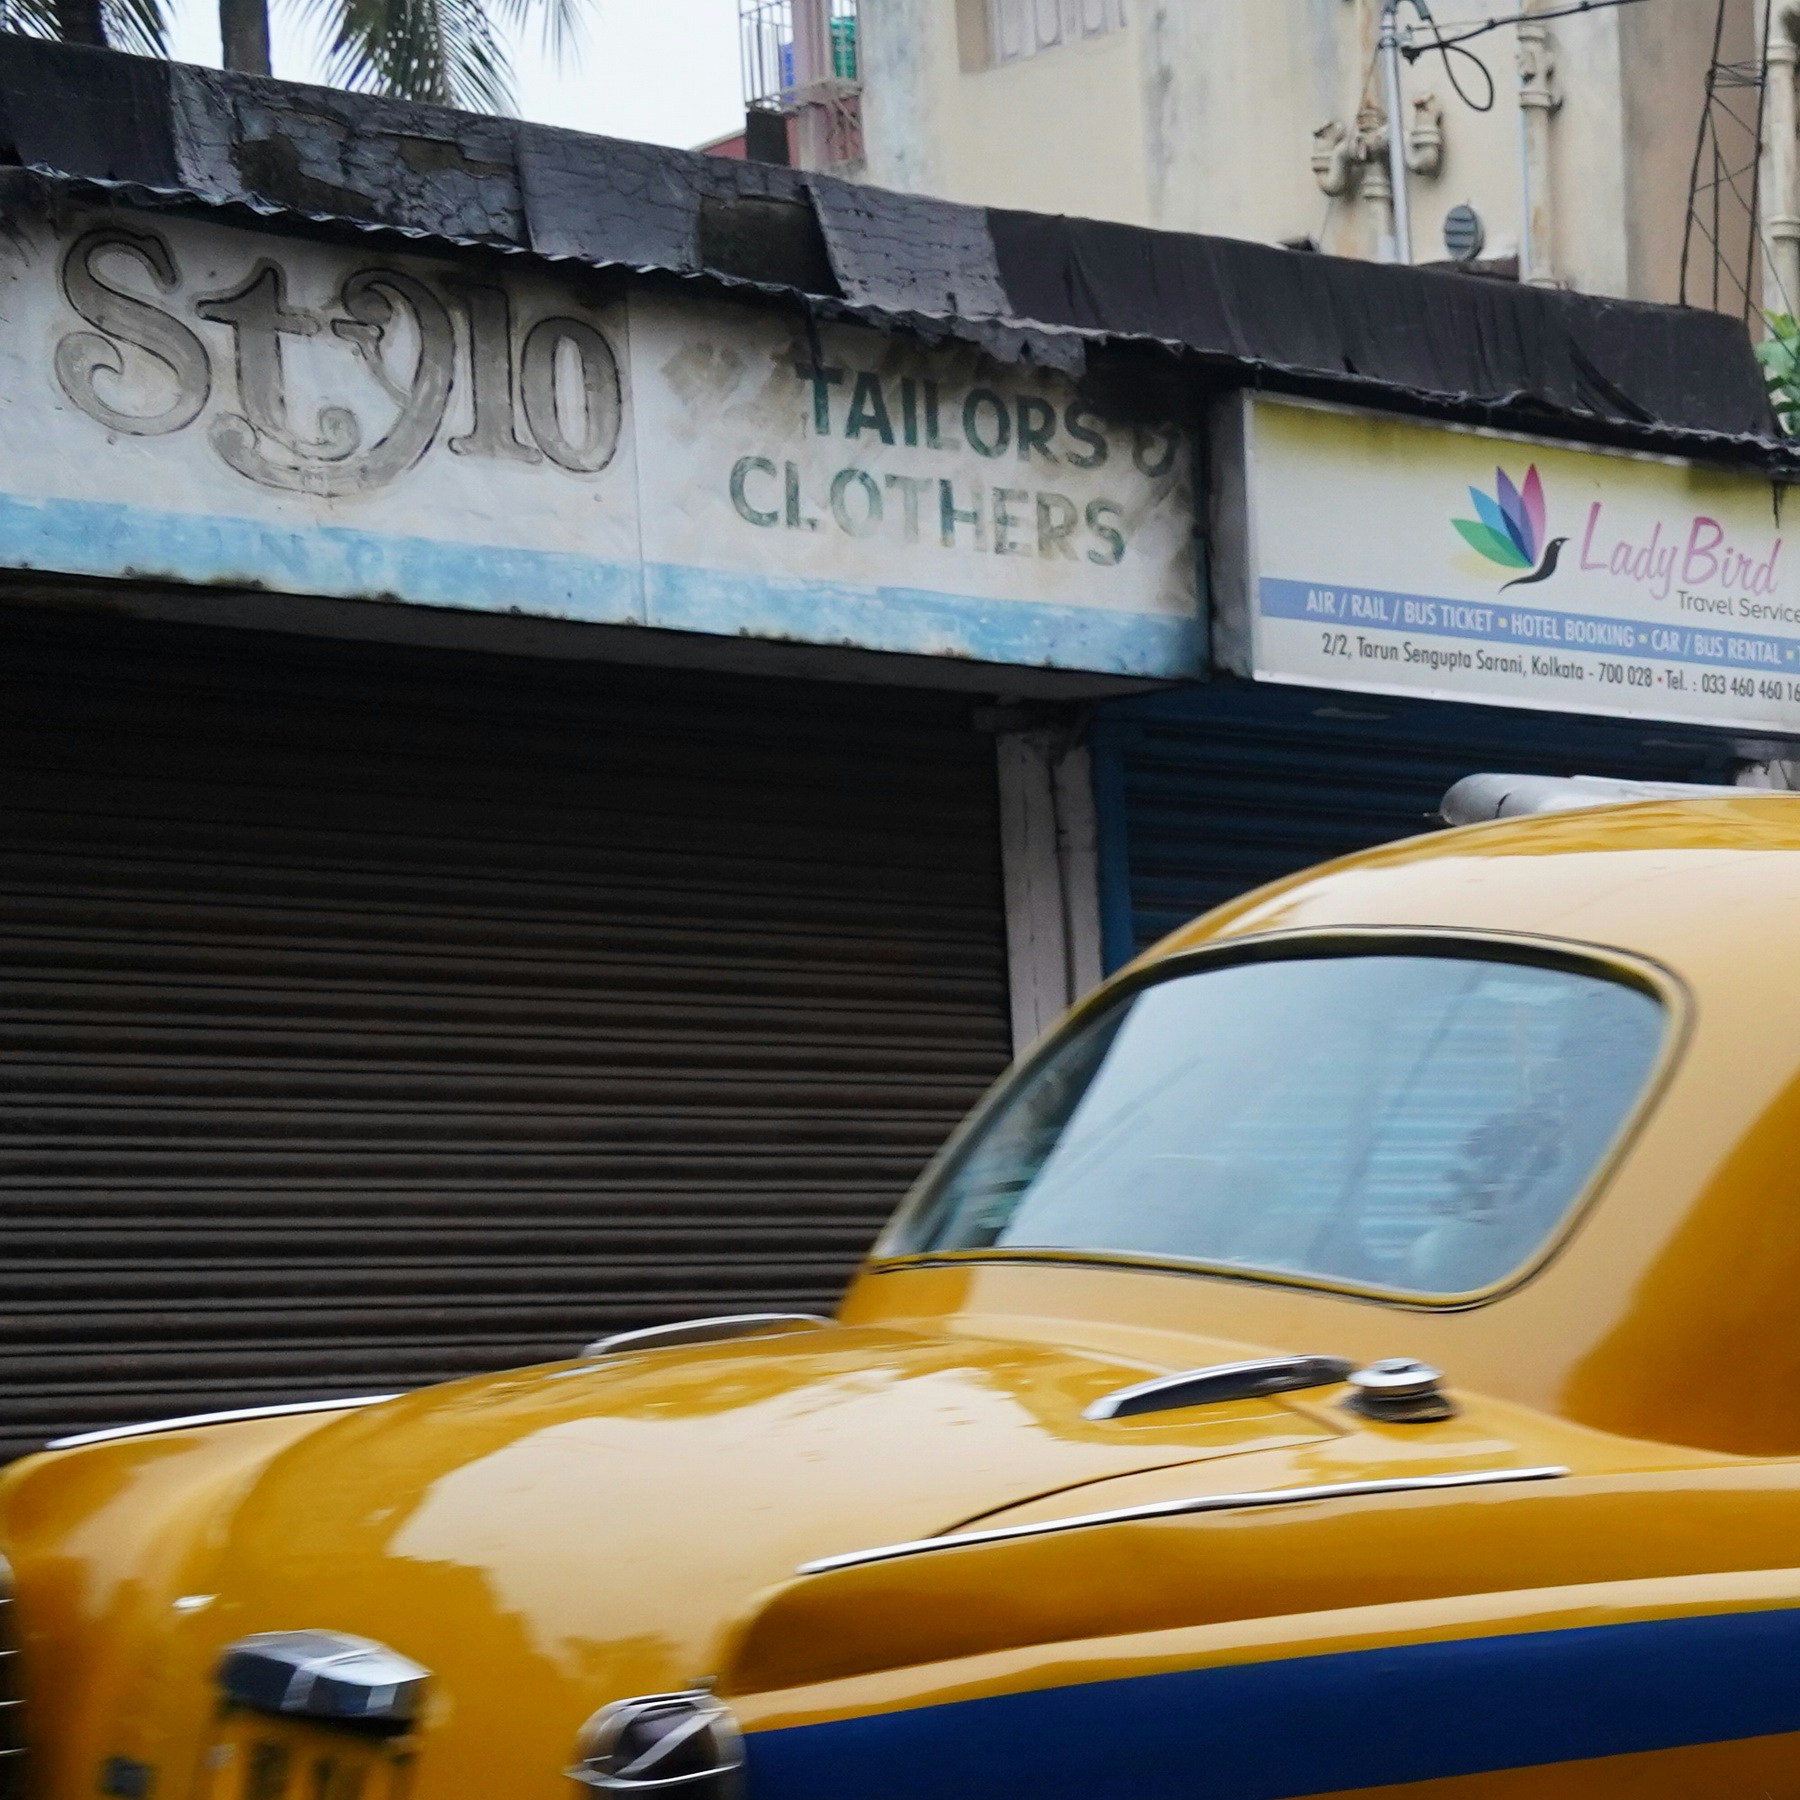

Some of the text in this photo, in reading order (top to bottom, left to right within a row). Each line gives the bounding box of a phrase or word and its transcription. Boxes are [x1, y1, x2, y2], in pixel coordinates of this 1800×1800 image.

[53, 225, 624, 498] Stylo
[796, 362, 1108, 469] TAILORS
[729, 456, 1125, 566] CLOTHERS
[1306, 589, 1335, 614] AIR
[1350, 594, 1388, 621] RAIL
[1404, 600, 1437, 626] BUS
[1442, 606, 1493, 632] TICKET
[1511, 615, 1561, 641] HOTEL
[1565, 619, 1635, 648] BOOKING
[1652, 629, 1679, 651] CAR
[1694, 634, 1724, 658] BUS
[1728, 637, 1782, 665] RENTAL
[1677, 590, 1733, 616] Travel
[1322, 632, 1352, 661] 2/2,
[1357, 636, 1398, 661] Tarun
[1403, 641, 1471, 672] Sengupta
[1476, 649, 1526, 678] Sarani,
[1532, 655, 1584, 681] Kolkata
[1599, 662, 1623, 684] 700
[1627, 665, 1652, 687] 028
[1665, 669, 1687, 691] Tel.
[1702, 674, 1725, 695] 033
[1730, 677, 1755, 698] 460
[1758, 679, 1782, 700] 460
[1788, 681, 1800, 702] 16
